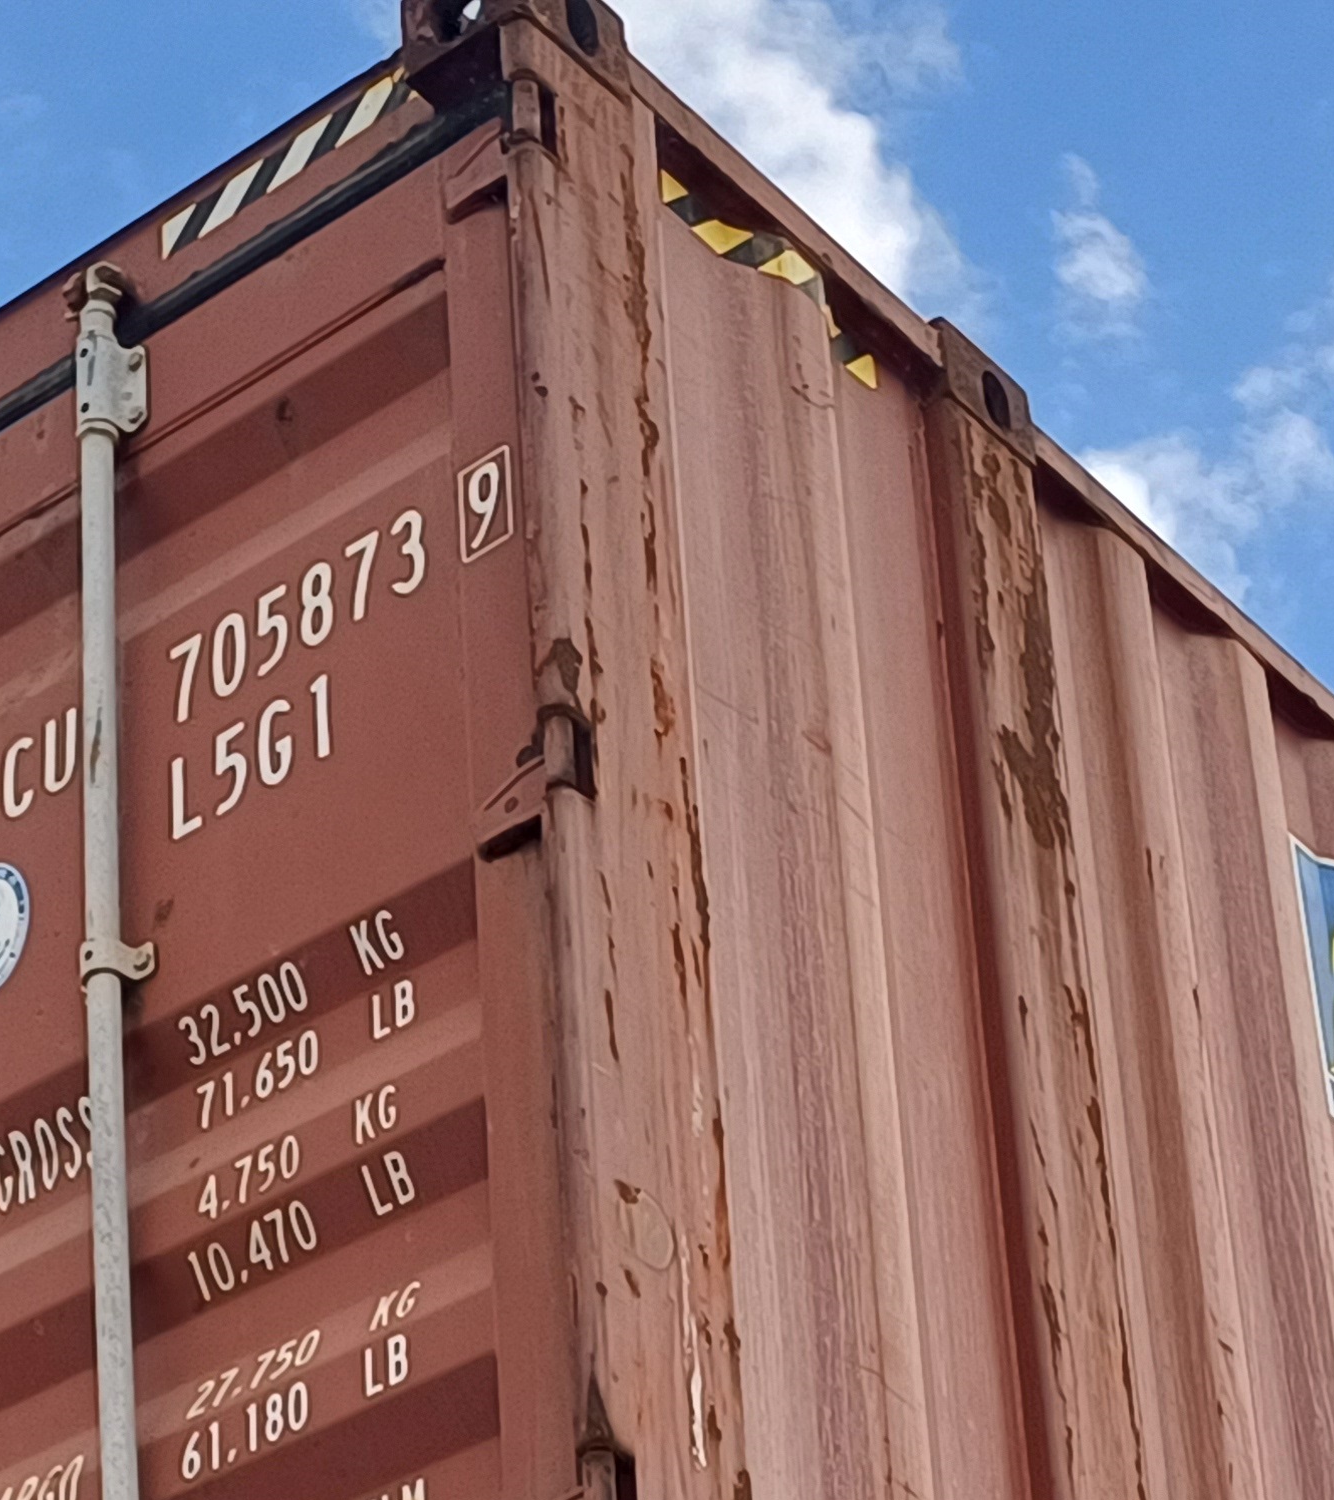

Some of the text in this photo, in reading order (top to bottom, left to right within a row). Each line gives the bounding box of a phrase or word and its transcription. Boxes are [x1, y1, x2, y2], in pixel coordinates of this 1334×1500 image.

[168, 508, 427, 724] 705873
[168, 673, 332, 841] L5G1
[349, 908, 405, 976] KG
[371, 980, 416, 1039] LB
[353, 1084, 397, 1144] KG
[359, 1150, 415, 1217] LB
[369, 1281, 421, 1333] KG
[363, 1334, 408, 1397] LB
